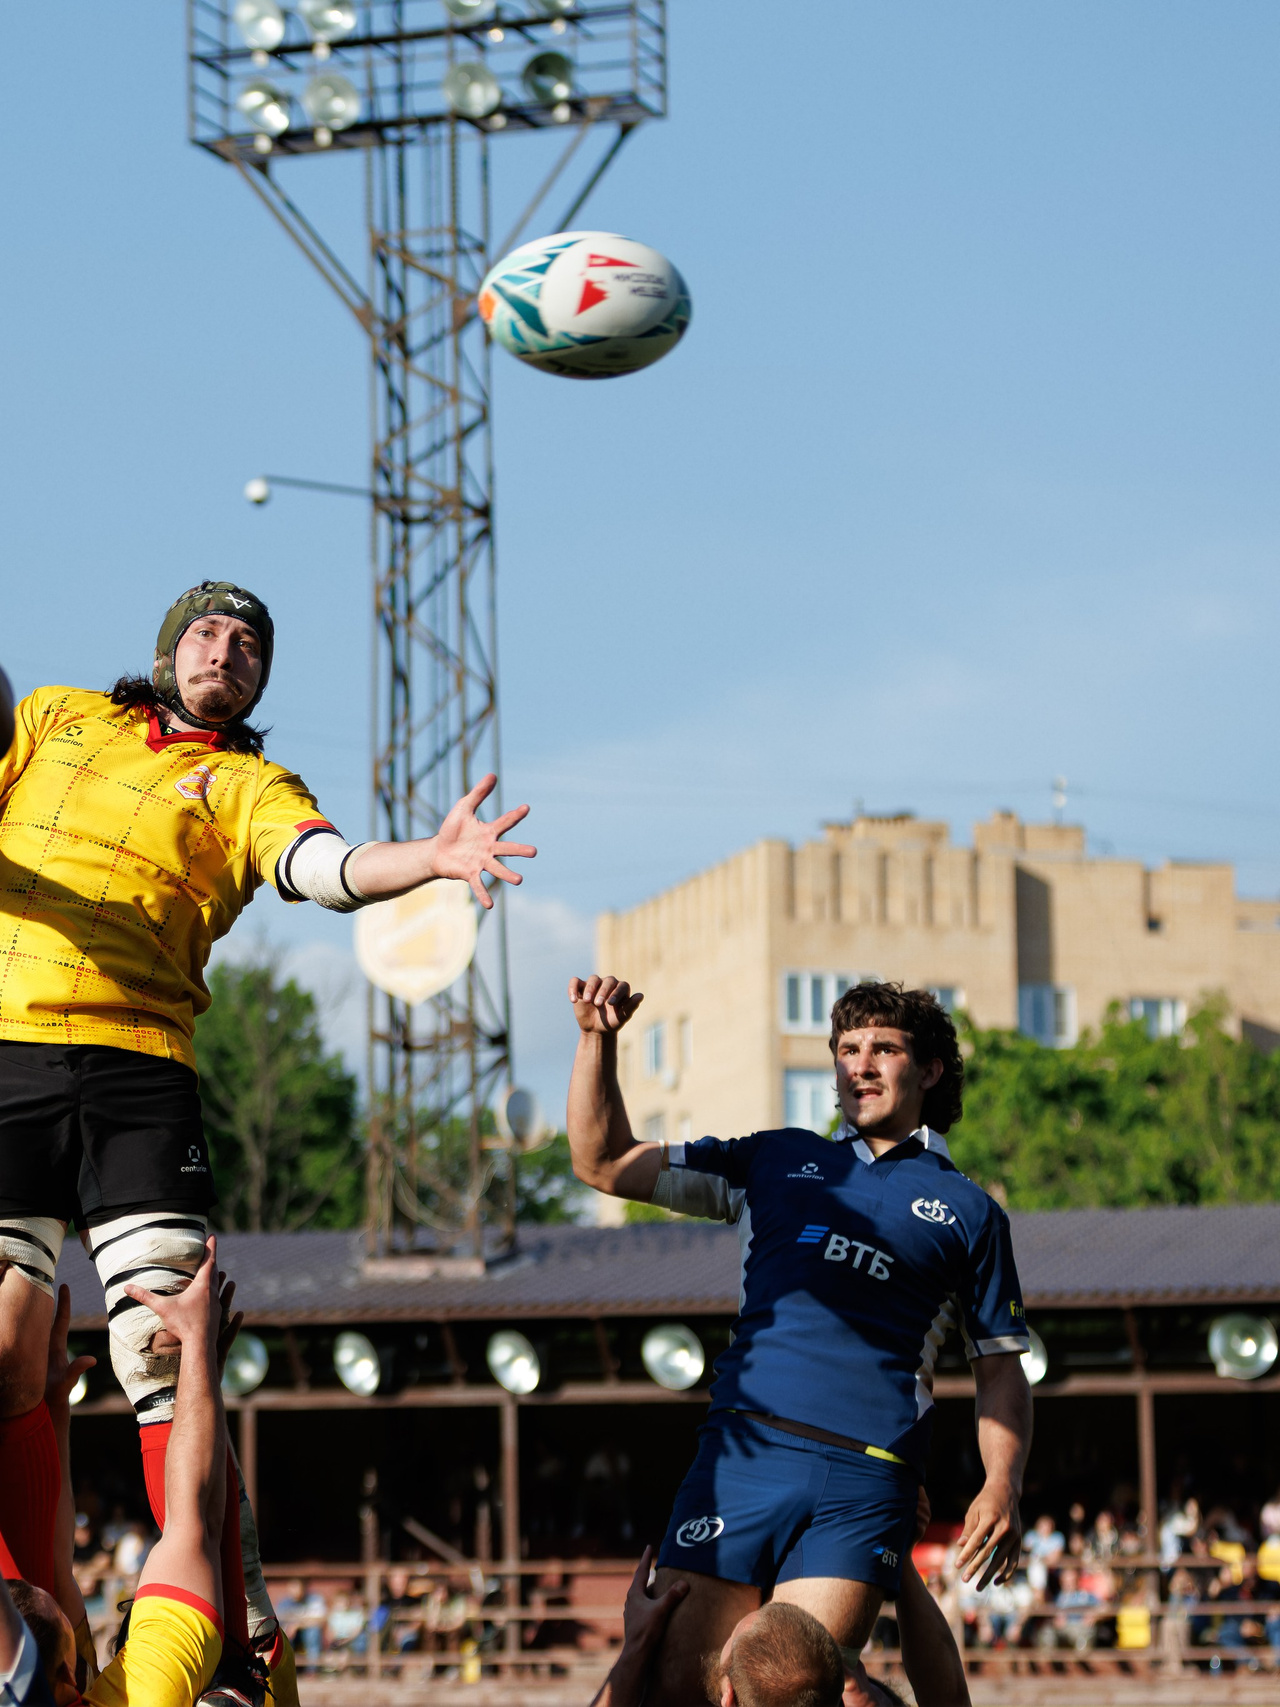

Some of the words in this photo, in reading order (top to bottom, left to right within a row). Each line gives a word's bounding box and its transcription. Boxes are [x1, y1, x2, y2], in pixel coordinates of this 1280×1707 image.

[51, 737, 84, 748] enturion
[823, 1233, 895, 1281] ВТБ
[881, 1548, 899, 1568] ВТБ
